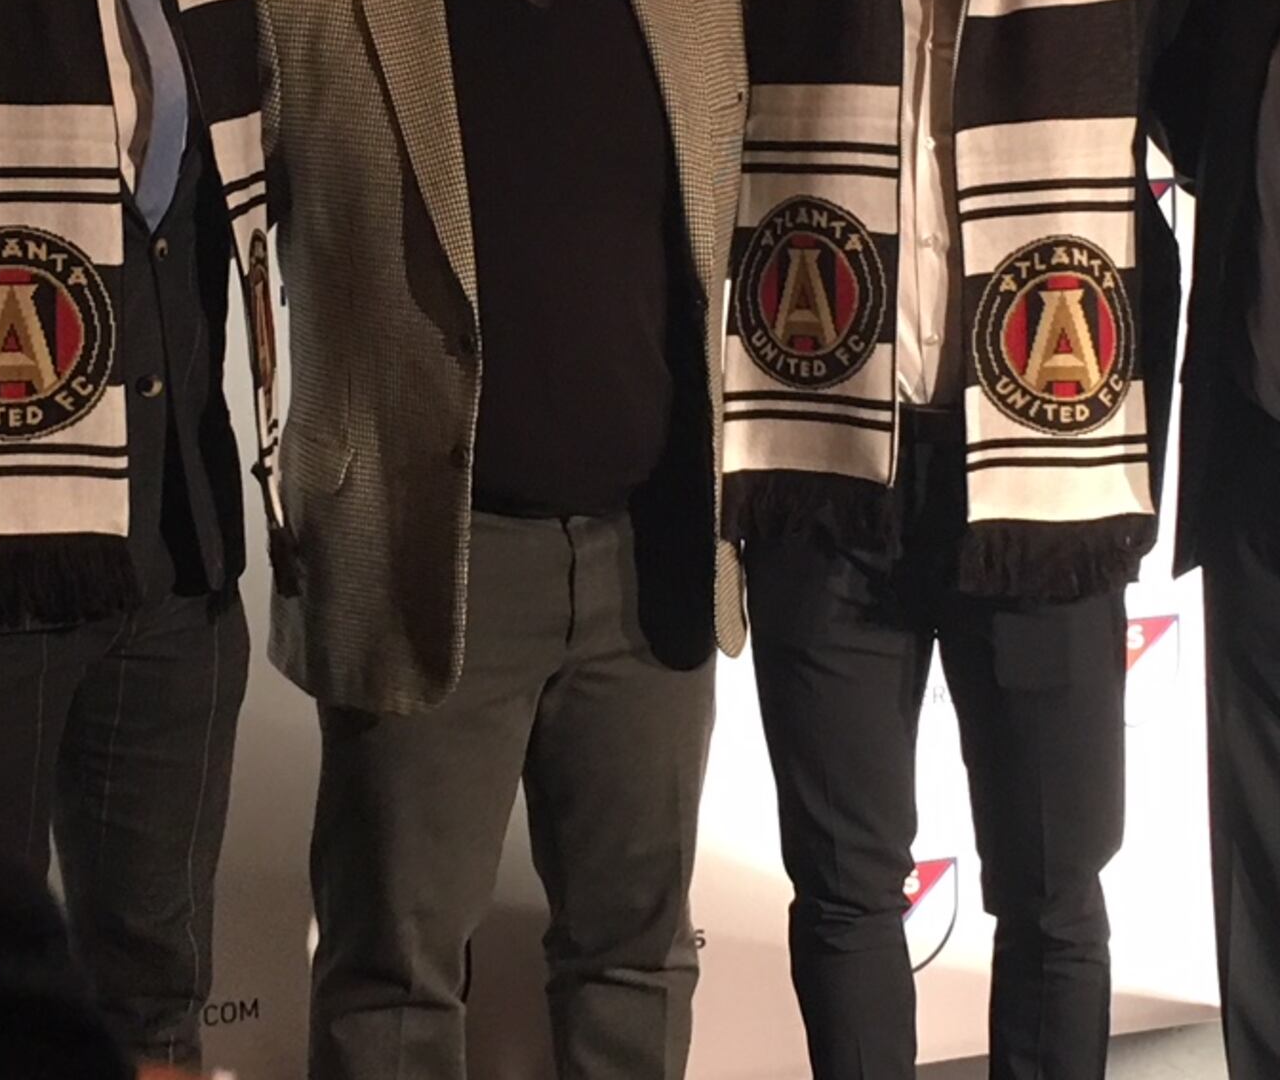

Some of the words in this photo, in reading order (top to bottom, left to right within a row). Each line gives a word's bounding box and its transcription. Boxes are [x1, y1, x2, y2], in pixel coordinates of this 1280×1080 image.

[760, 207, 863, 252] ATLANTA
[999, 246, 1115, 293] ATLANTA
[751, 329, 827, 378] UNITED
[834, 335, 865, 366] FC
[54, 376, 94, 411] FC
[995, 376, 1091, 424] UNITED
[1098, 373, 1124, 408] FC
